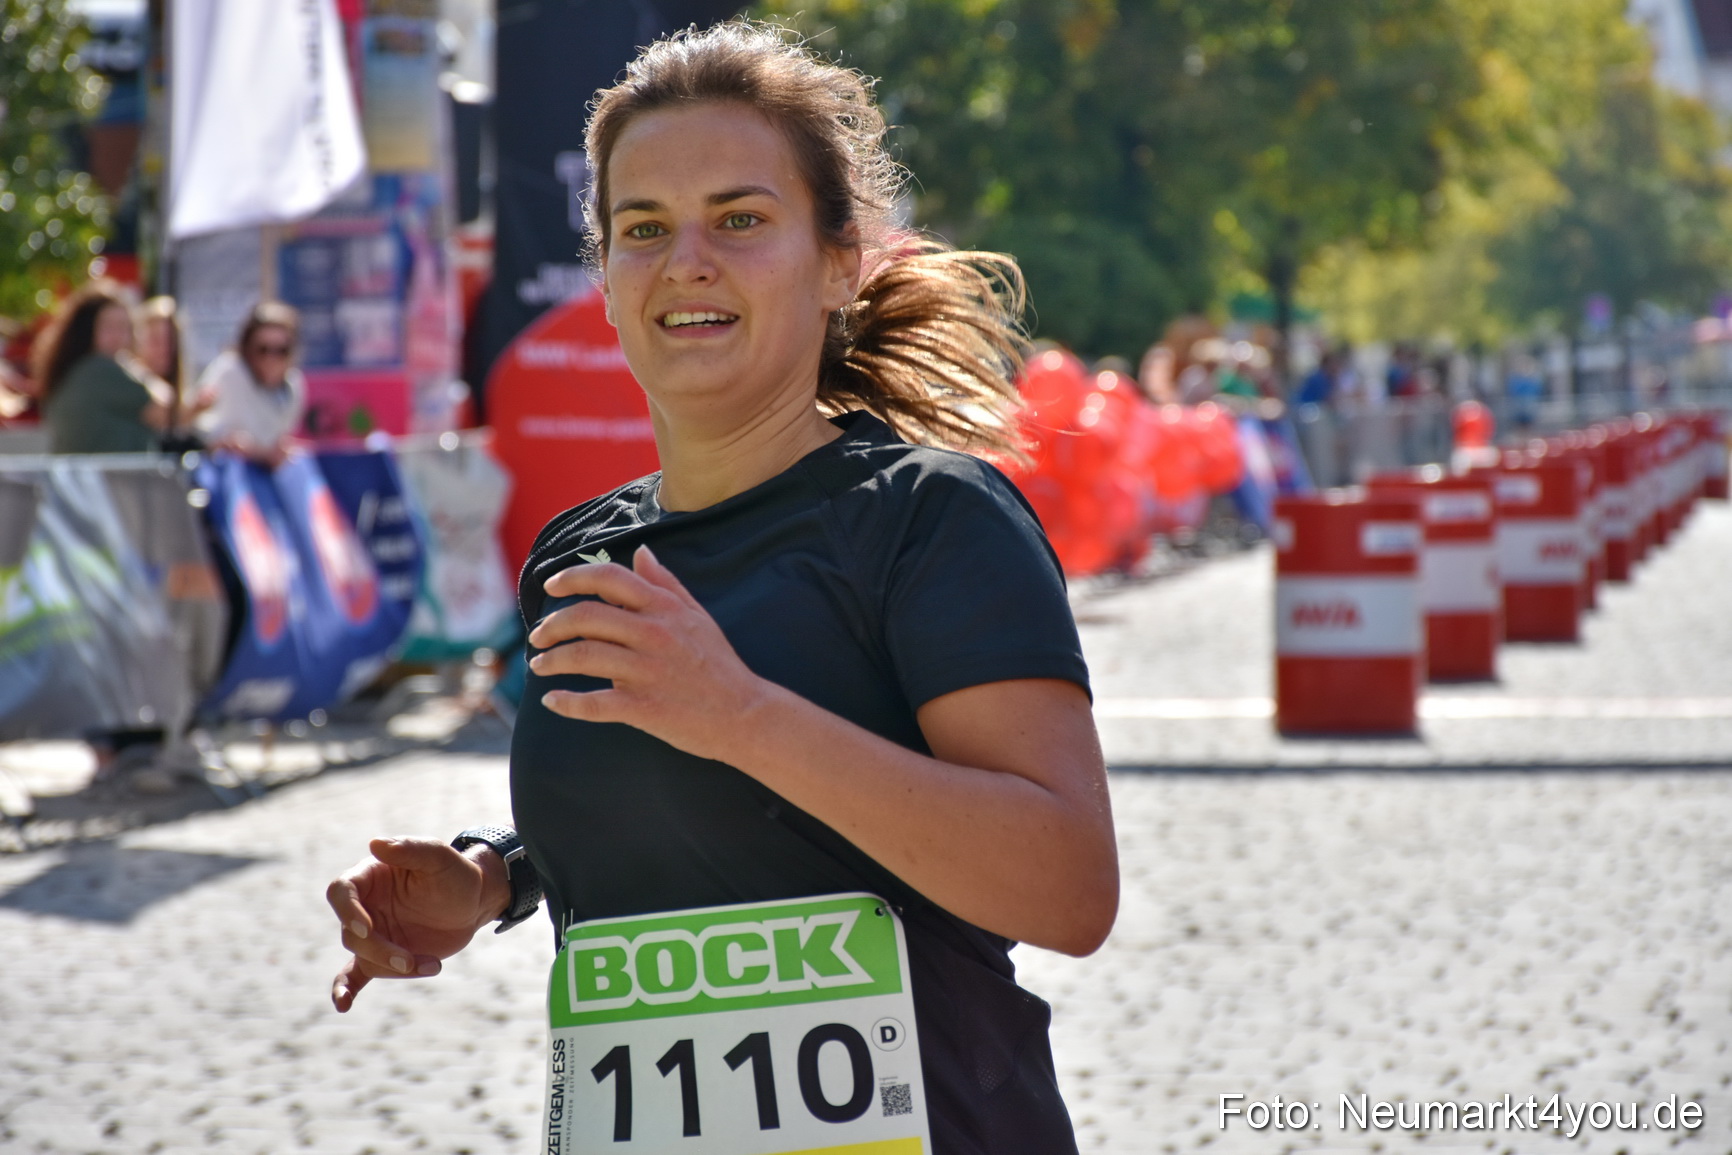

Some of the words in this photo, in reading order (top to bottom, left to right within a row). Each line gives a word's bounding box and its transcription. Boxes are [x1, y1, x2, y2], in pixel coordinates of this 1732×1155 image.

[568, 910, 875, 1014] BOCK
[590, 1022, 875, 1143] 1110
[880, 1025, 897, 1044] D
